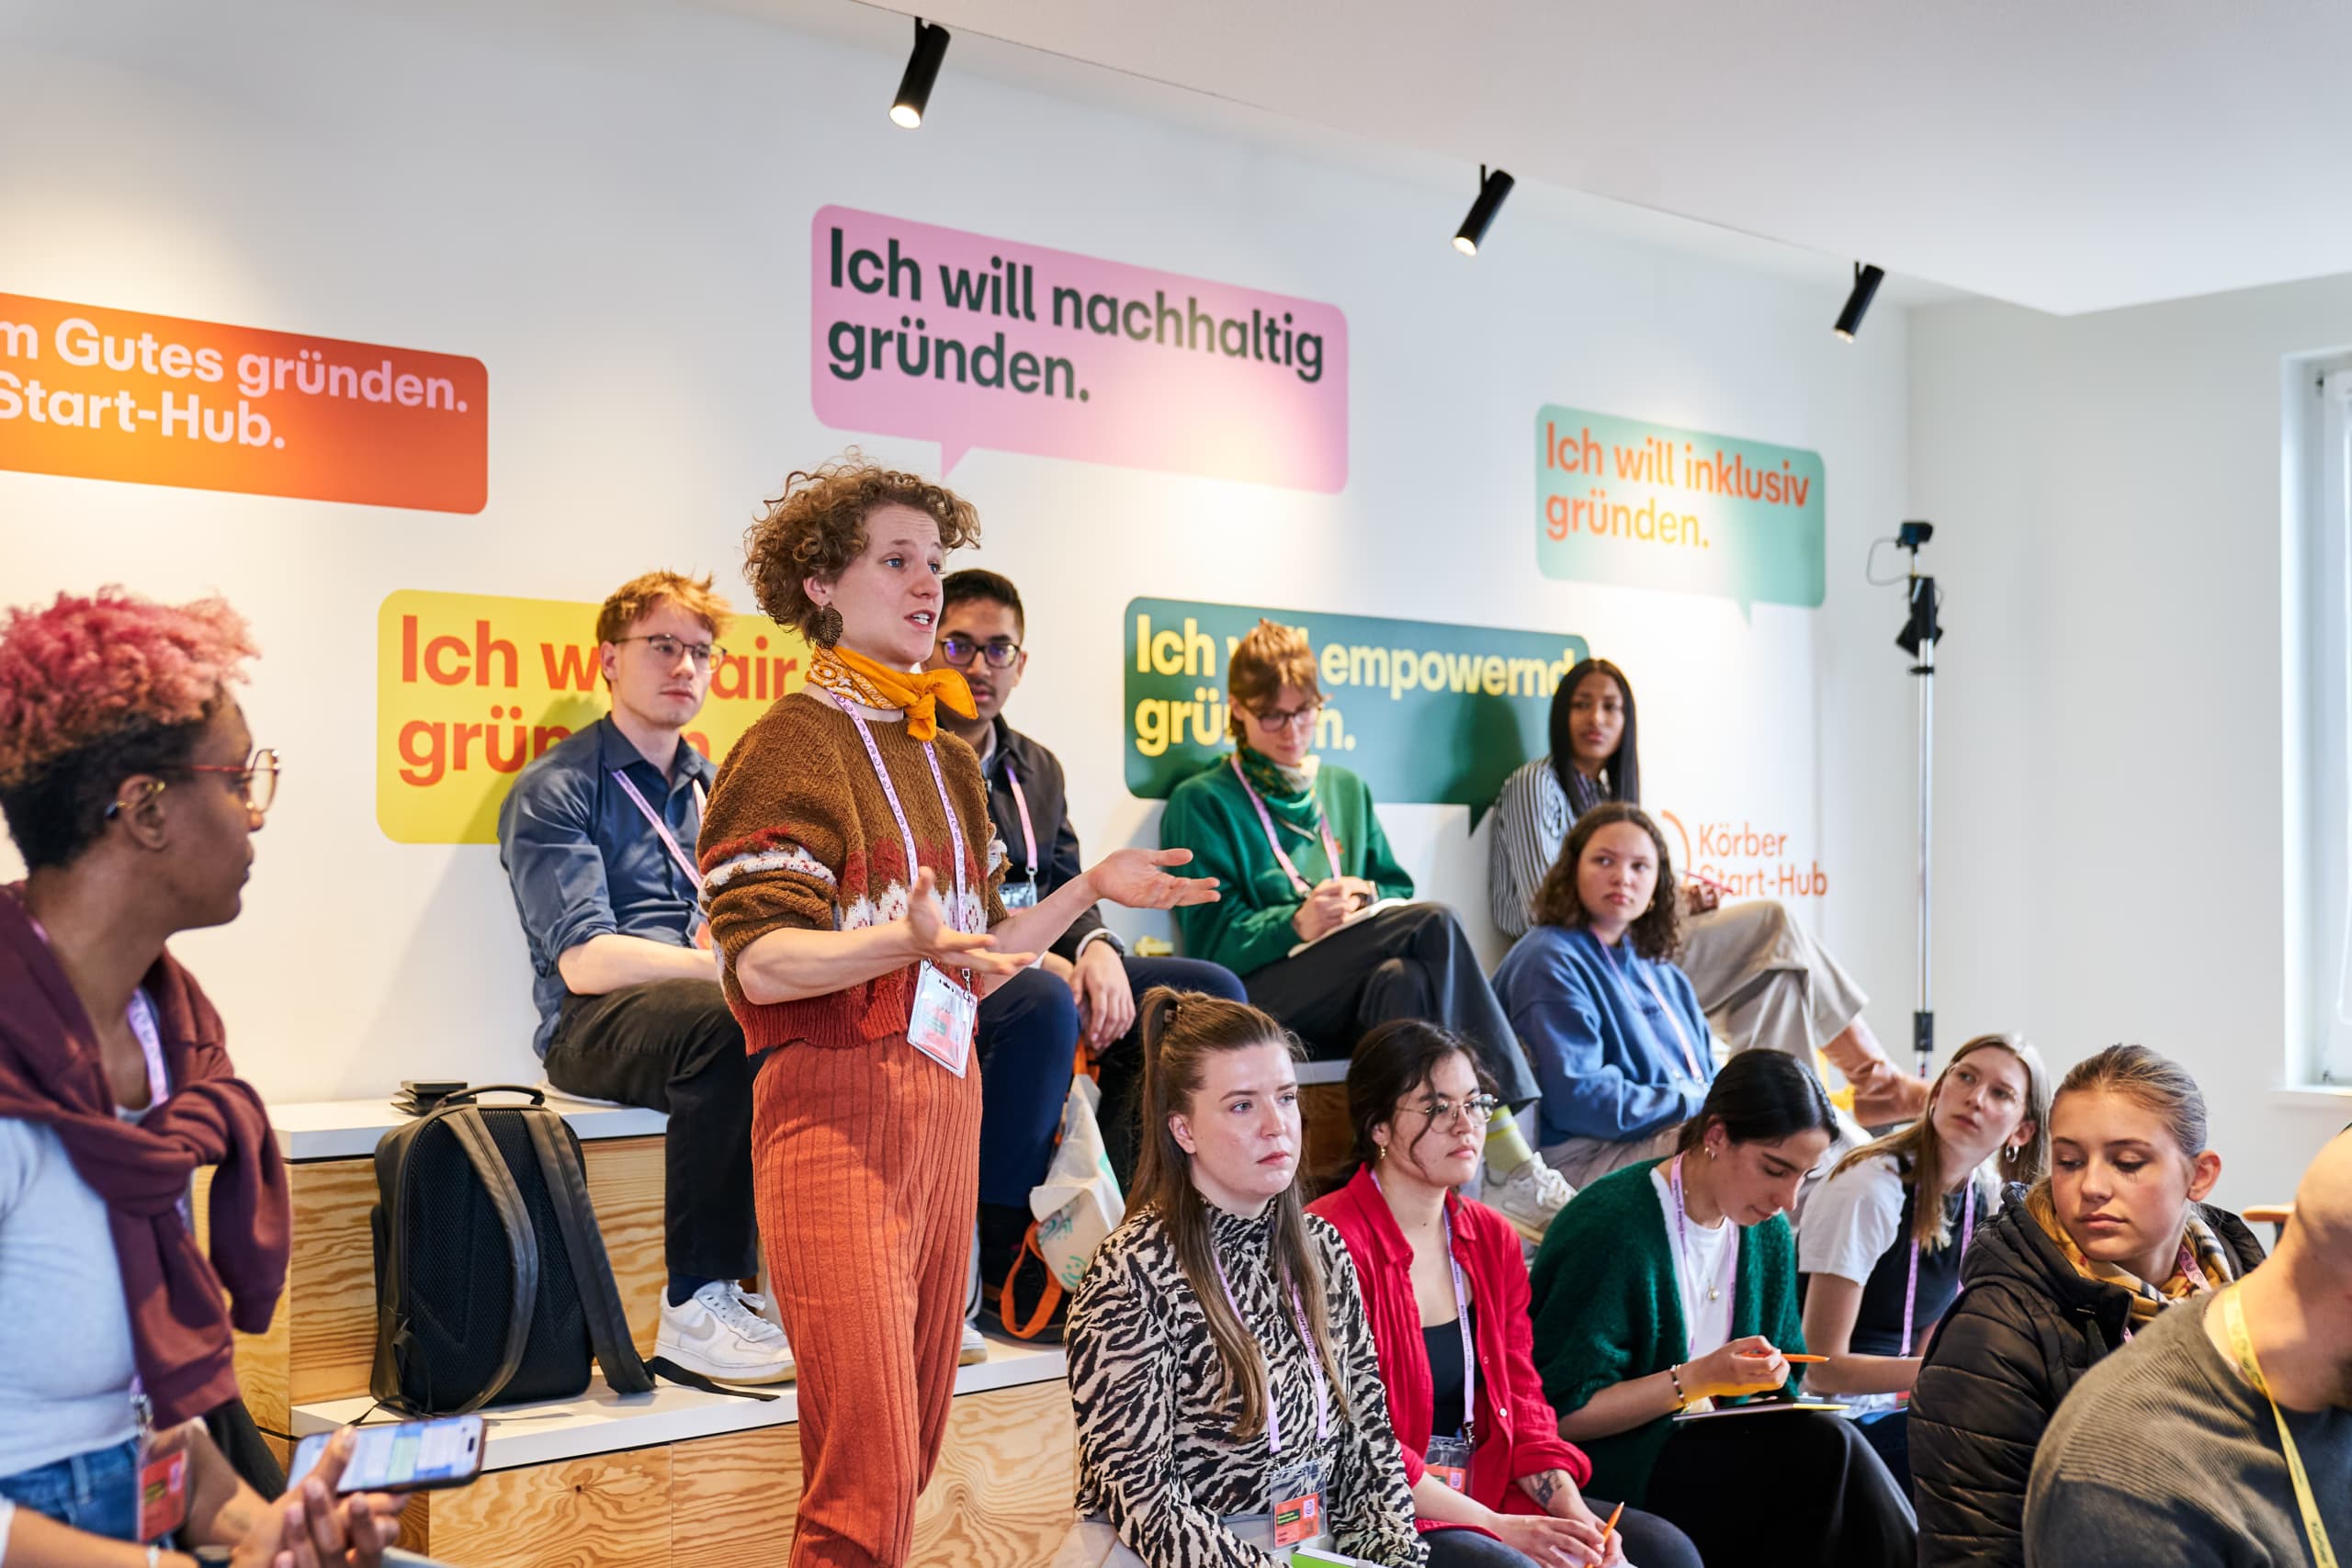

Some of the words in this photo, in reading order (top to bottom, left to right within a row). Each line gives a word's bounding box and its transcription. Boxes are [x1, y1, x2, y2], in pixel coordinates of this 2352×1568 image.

[831, 227, 922, 301] Ich
[939, 255, 1036, 321] will
[1052, 286, 1323, 383] nachhaltig
[55, 318, 223, 382] Gutes
[238, 349, 468, 412] gründen.
[828, 316, 1090, 402] gründen.
[1546, 421, 1603, 476] Ich
[1613, 435, 1675, 487] will
[1684, 443, 1810, 508] inklusiv
[1544, 488, 1710, 549] gründen.
[402, 615, 518, 688] Ich
[710, 636, 797, 701] air
[1136, 614, 1216, 677] Ich
[1698, 820, 1788, 858] Körber
